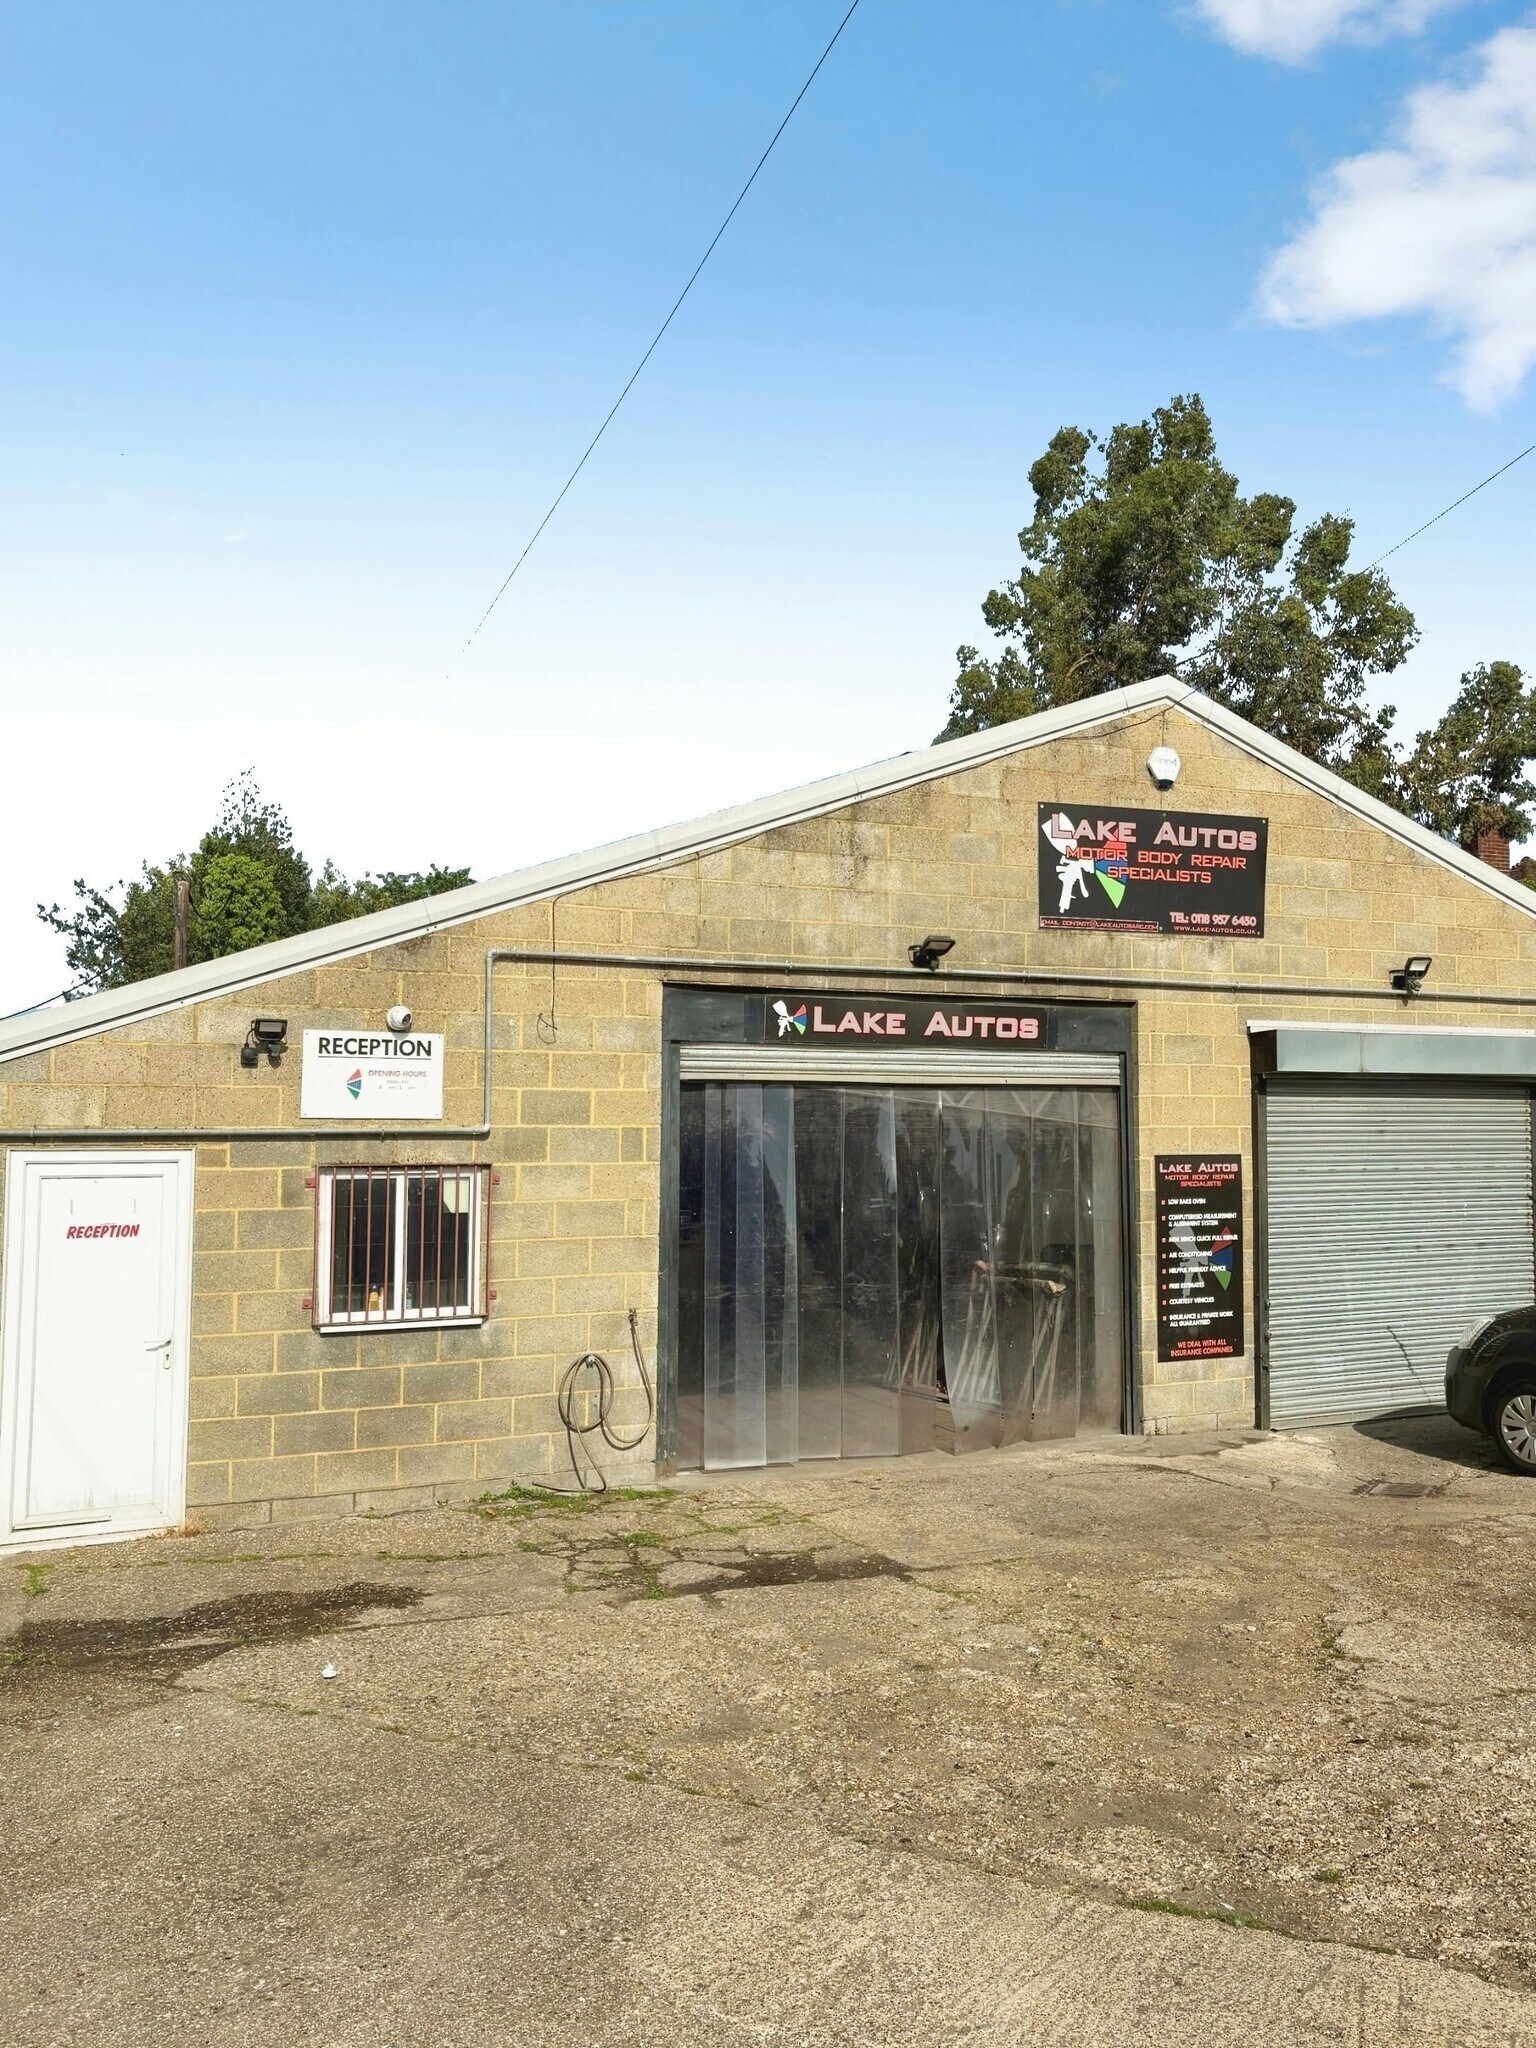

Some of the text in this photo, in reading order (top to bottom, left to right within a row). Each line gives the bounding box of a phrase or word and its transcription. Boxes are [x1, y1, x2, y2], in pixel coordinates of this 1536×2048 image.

[1051, 813, 1257, 851] LAKE AUTOS
[1066, 846, 1247, 869] MOTOR BODY REPAIR
[1107, 866, 1212, 884] SPECIALISTS
[1169, 912, 1257, 927] TEL: 0118 957 6450
[813, 1006, 1039, 1039] LAKE AUTOS
[318, 1037, 432, 1057] RECEPTION
[1159, 1162, 1238, 1173] LAKE AUTOS
[66, 1224, 140, 1239] RECEPTION
[1202, 1339, 1216, 1347] WITH
[1170, 1346, 1233, 1357] INSURANCE COMPANIES
